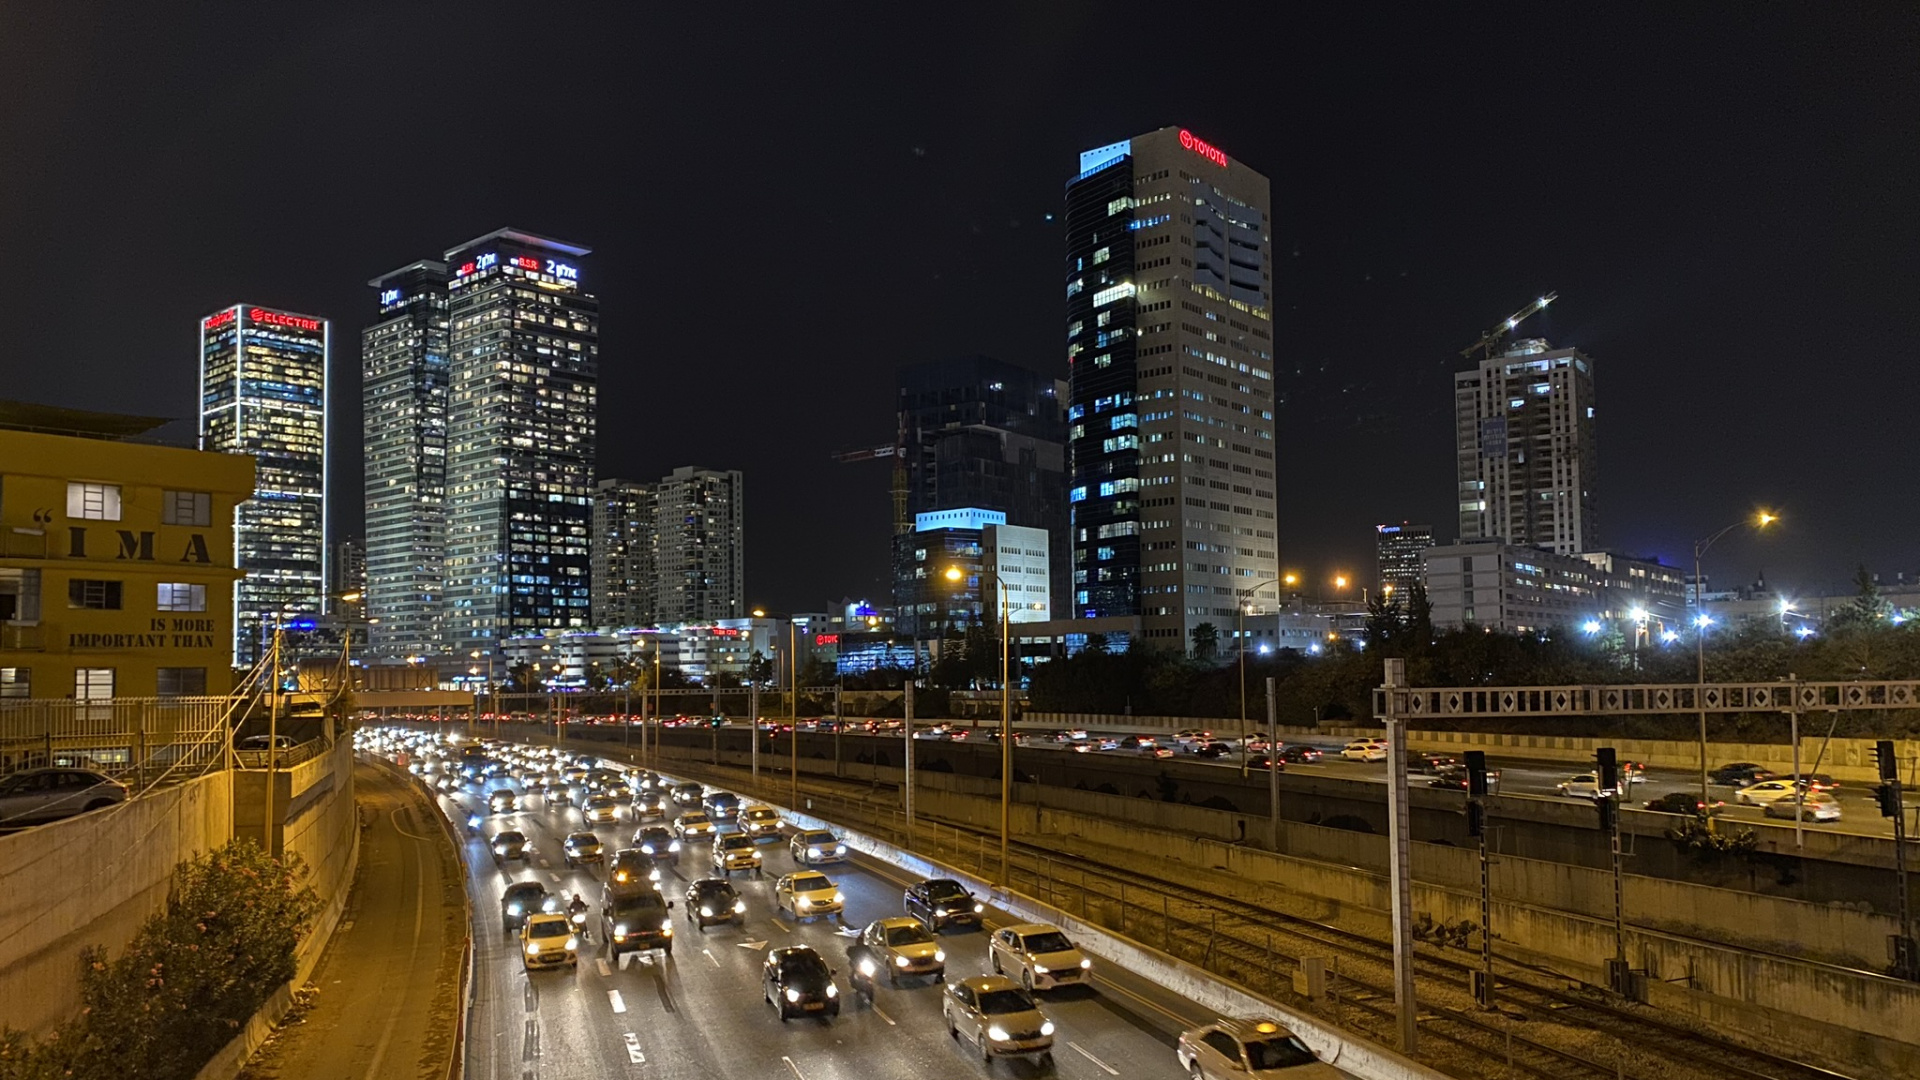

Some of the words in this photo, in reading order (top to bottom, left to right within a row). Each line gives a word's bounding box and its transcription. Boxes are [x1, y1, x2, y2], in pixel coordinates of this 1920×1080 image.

[1193, 138, 1227, 167] TOYOTA
[476, 256, 482, 269] 2
[546, 260, 555, 274] 2
[264, 312, 317, 330] ELECTRA
[150, 618, 166, 631] IS
[172, 618, 215, 633] MORE
[69, 633, 167, 648] IMPORTANT
[172, 635, 214, 648] THAN
